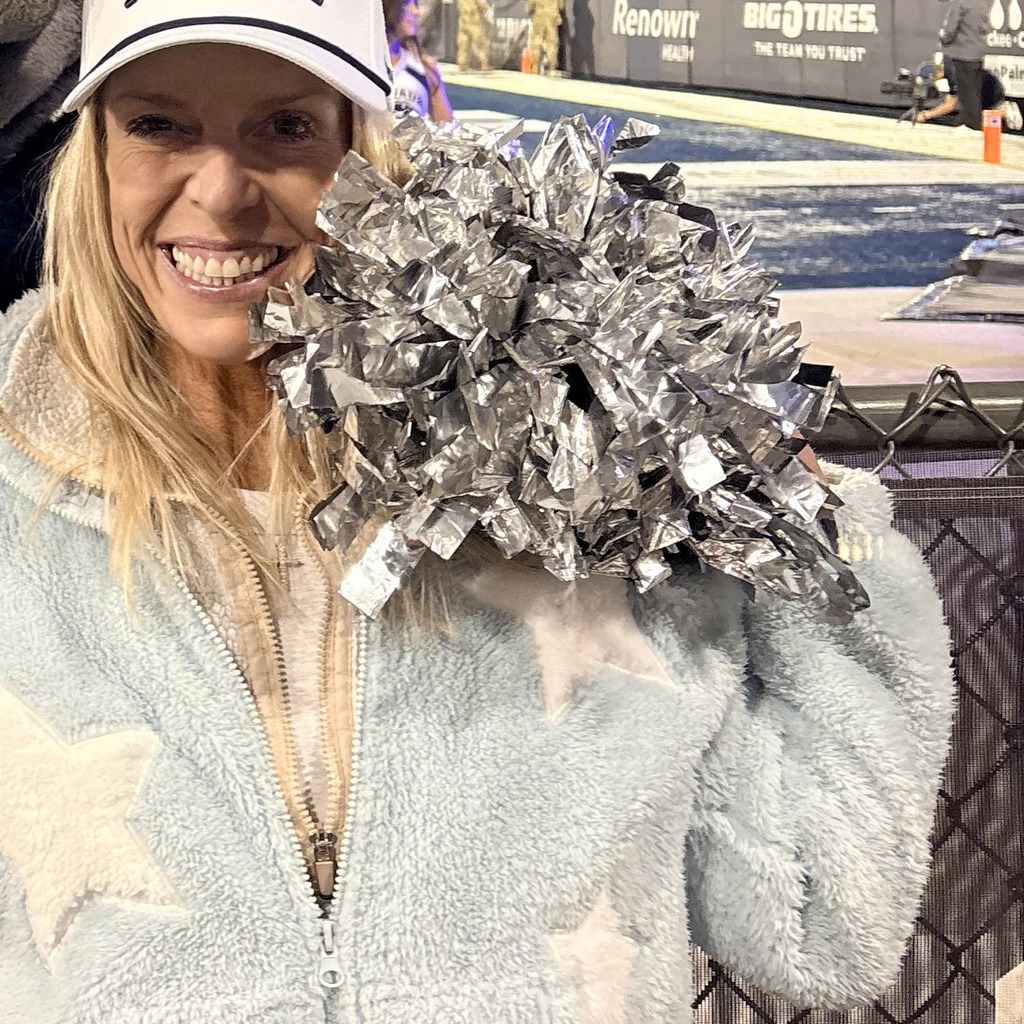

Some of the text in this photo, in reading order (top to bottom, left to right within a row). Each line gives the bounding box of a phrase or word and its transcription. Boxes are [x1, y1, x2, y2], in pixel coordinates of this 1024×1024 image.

[754, 41, 864, 62] THE TEAM YOU TRUST
